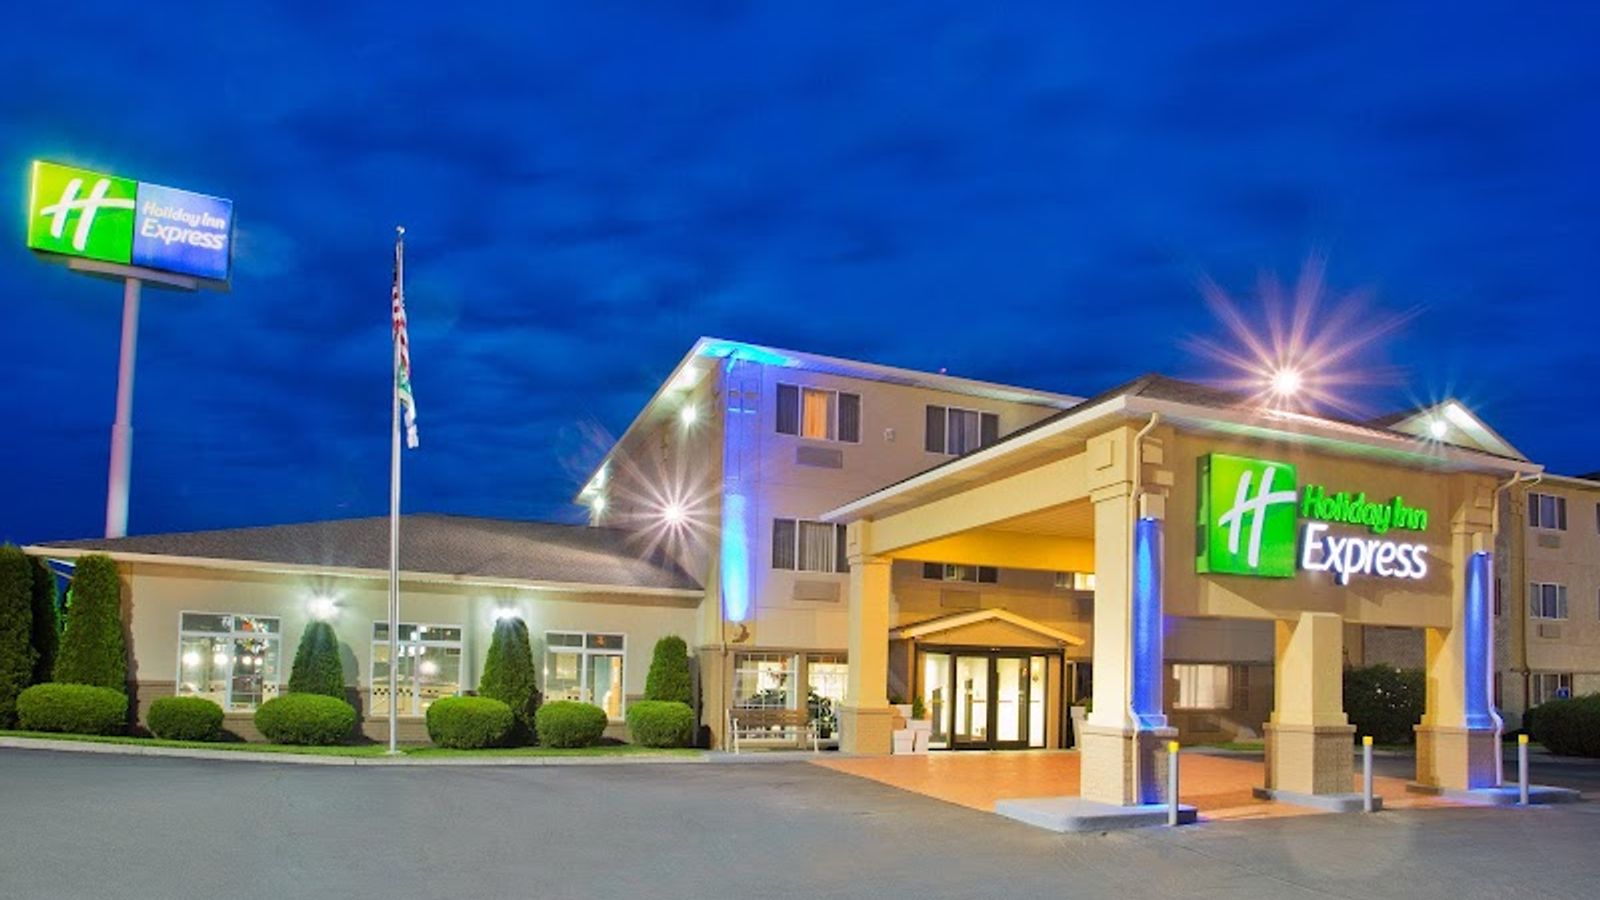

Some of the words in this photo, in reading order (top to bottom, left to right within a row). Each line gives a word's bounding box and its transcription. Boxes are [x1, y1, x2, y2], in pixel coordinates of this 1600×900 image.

[140, 218, 226, 250] Express
[142, 201, 199, 226] Holiday
[199, 211, 226, 230] Inn
[1302, 484, 1391, 534] Holiday
[1391, 496, 1428, 531] Inn
[1301, 521, 1428, 586] Express
